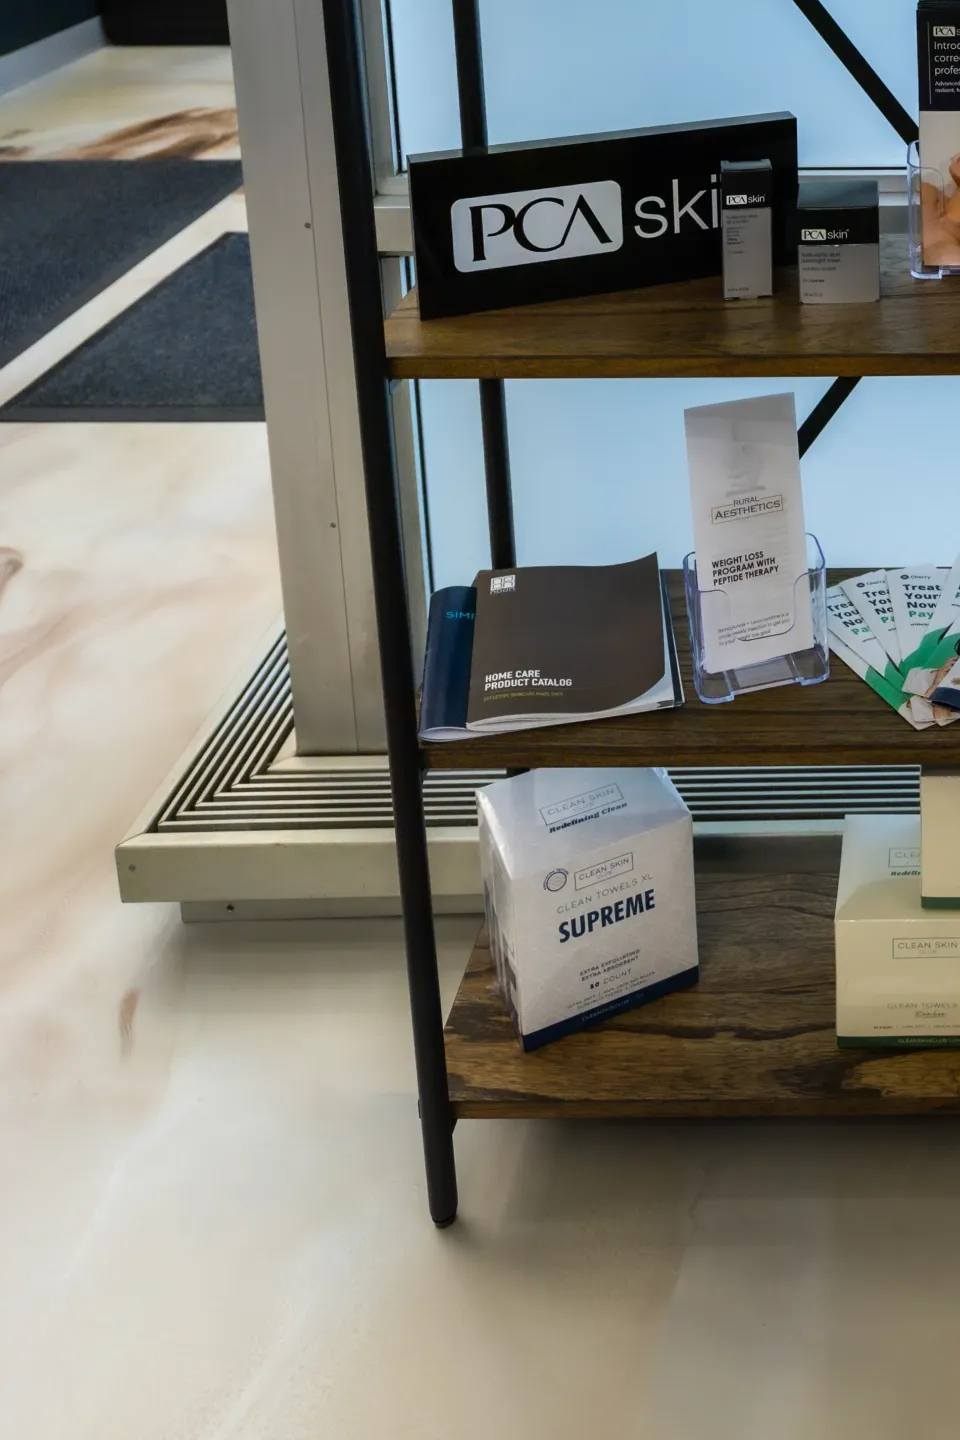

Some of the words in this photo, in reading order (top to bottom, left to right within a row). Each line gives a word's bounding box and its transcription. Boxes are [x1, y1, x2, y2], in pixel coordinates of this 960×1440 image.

[469, 193, 613, 262] PCA
[634, 174, 722, 239] ski
[715, 500, 780, 520] AESTHETICS
[733, 496, 760, 506] RURAL
[712, 555, 742, 569] WEIGHT
[744, 550, 764, 562] LOSS
[712, 562, 754, 577] PROGRAM
[757, 557, 776, 568] WITH
[713, 574, 743, 586] PEPTIDE
[745, 565, 779, 579] THERAPY
[908, 611, 933, 620] Pay
[485, 671, 512, 683] HOME
[515, 670, 540, 678] CARE
[485, 679, 528, 691] PRODUCT
[532, 678, 572, 686] CATALOG
[547, 798, 585, 816] CLEAN
[588, 788, 615, 801] SKIN
[549, 812, 600, 833] Redefining
[601, 803, 627, 815] Clean
[578, 866, 607, 881] CLEAN
[610, 857, 629, 869] SKIN
[557, 896, 592, 914] CLEAN
[596, 878, 638, 897] TOWELS
[641, 874, 653, 883] XL
[558, 888, 656, 944] SUPREME
[580, 965, 600, 976] EXTRA
[601, 949, 640, 968] EXFOLIATING
